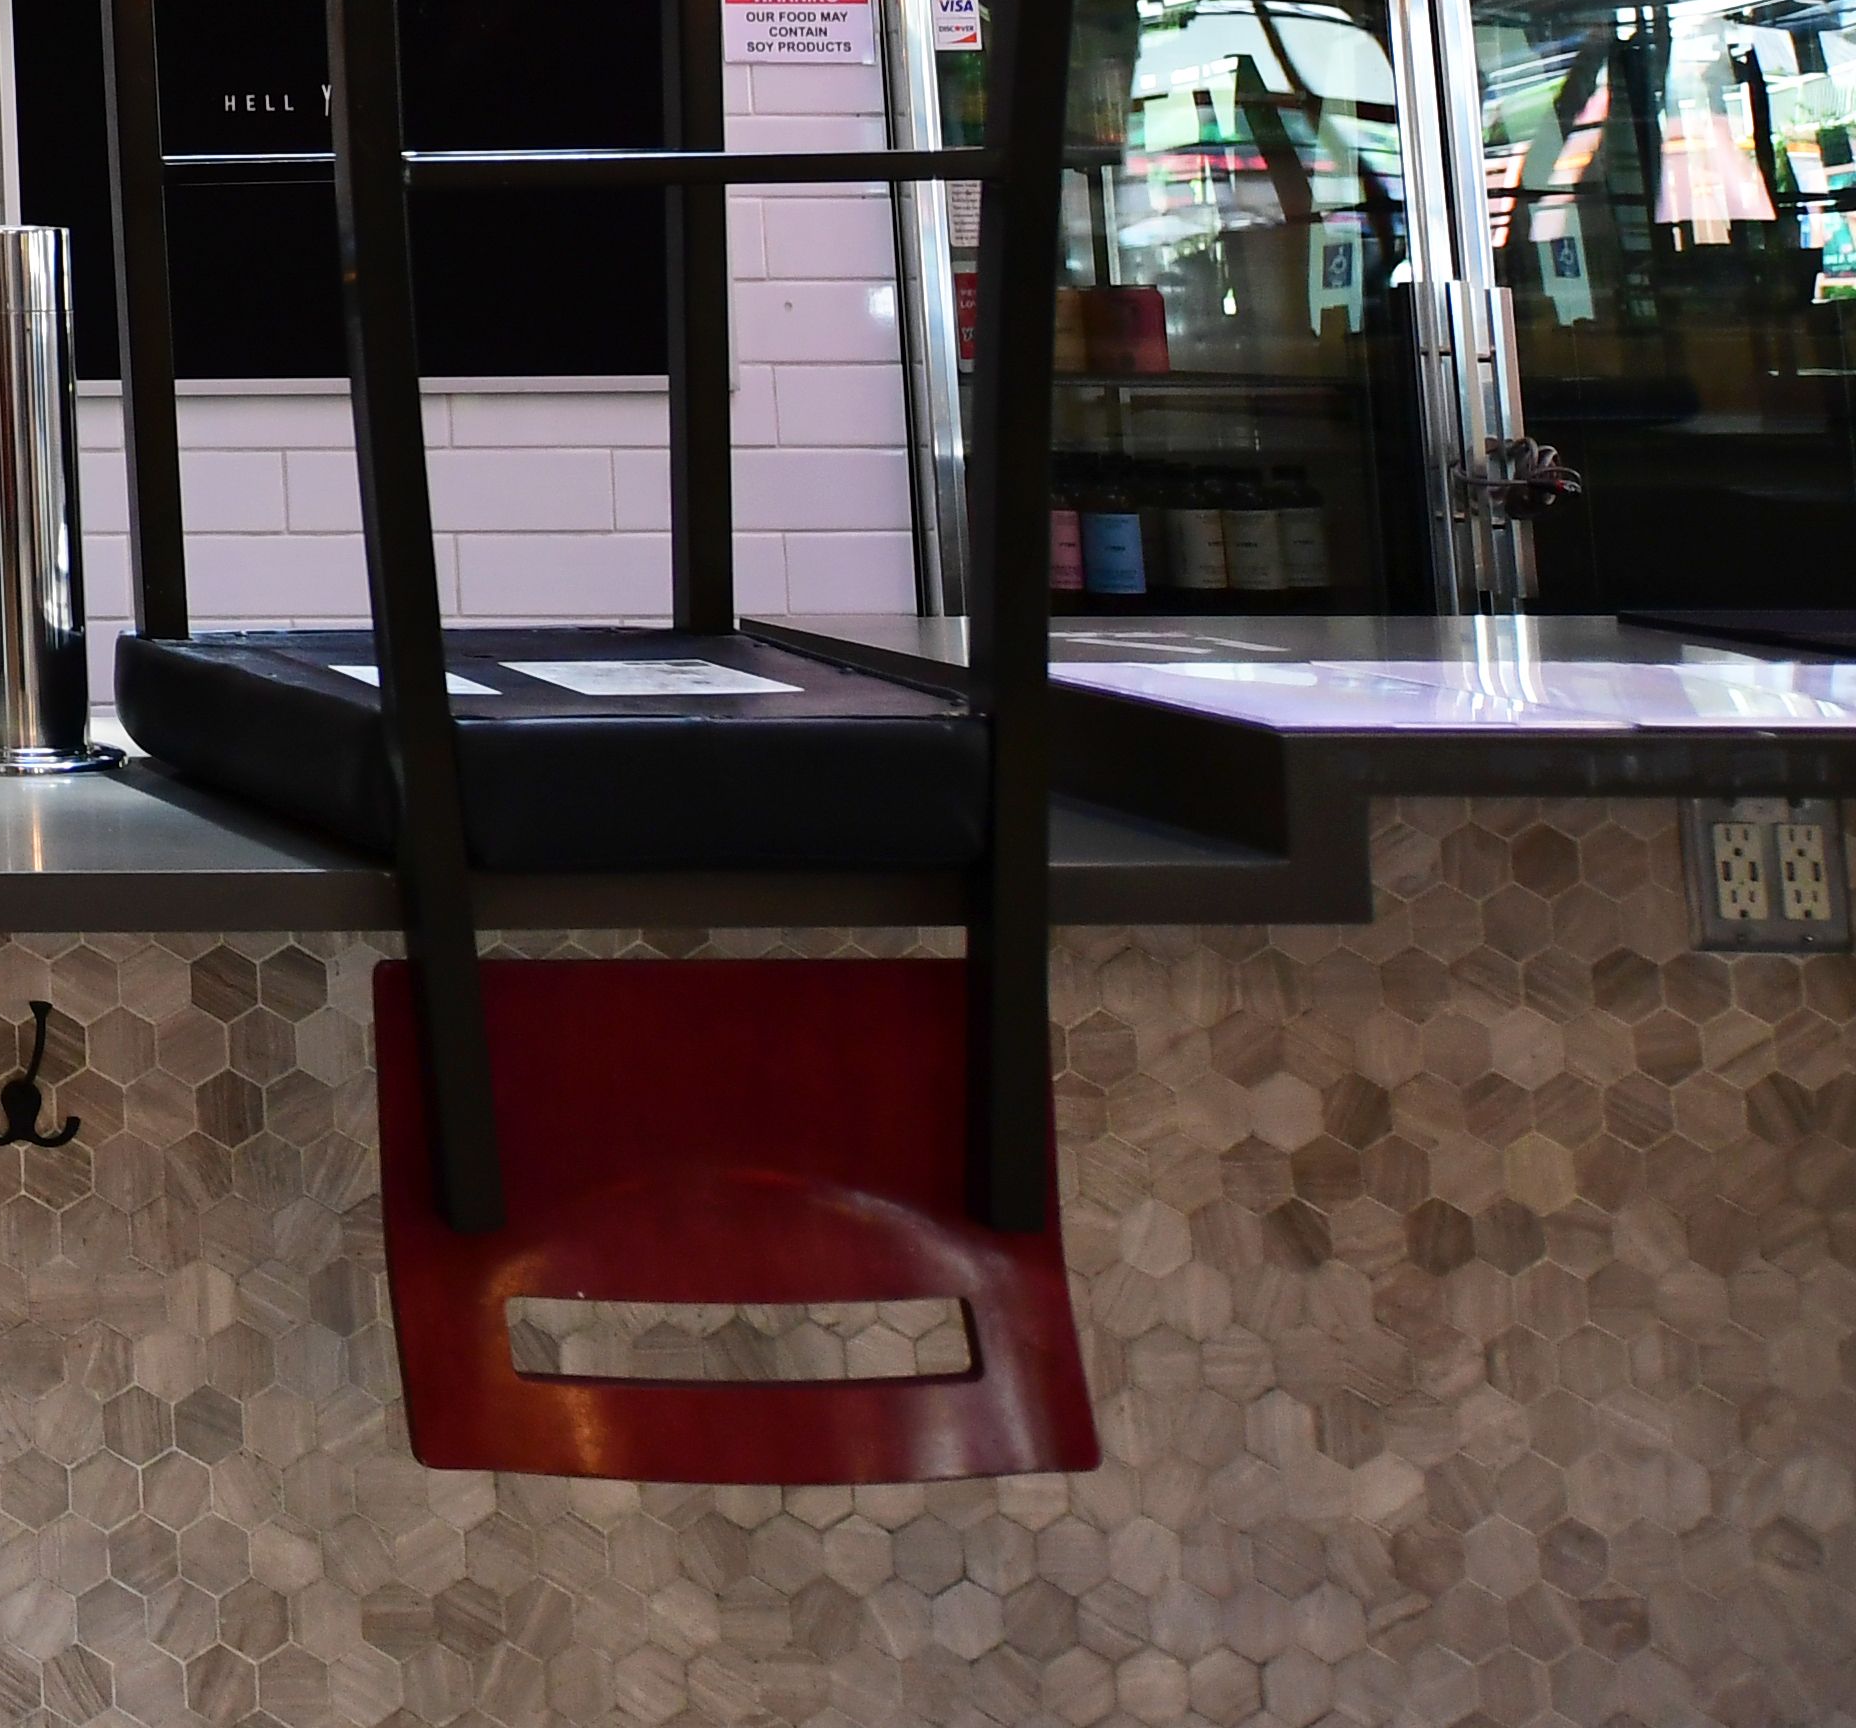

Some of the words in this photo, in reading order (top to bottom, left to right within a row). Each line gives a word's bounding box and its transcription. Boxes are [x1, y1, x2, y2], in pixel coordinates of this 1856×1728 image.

[939, 0, 974, 13] VISA
[746, 11, 775, 22] OUR
[779, 11, 817, 22] FOOD
[821, 11, 848, 22] MAY
[769, 26, 828, 37] CONTAIN
[747, 41, 774, 52] SOY
[778, 41, 852, 52] PRODUCTS
[224, 94, 295, 112] HELL
